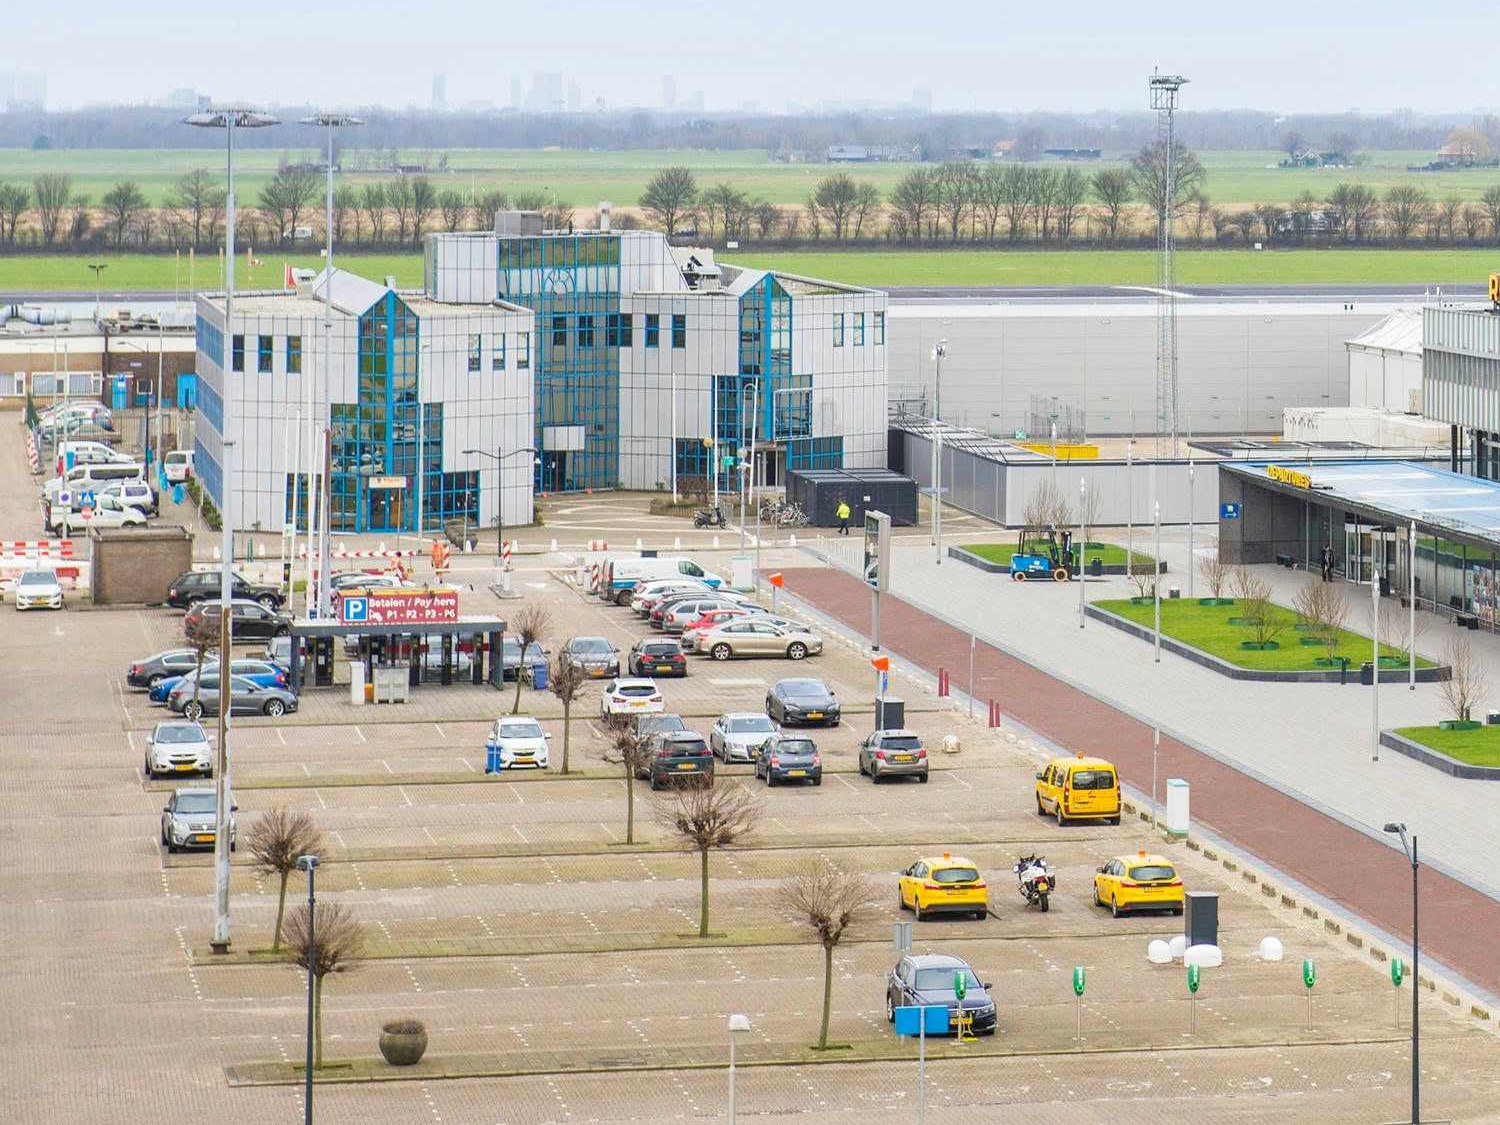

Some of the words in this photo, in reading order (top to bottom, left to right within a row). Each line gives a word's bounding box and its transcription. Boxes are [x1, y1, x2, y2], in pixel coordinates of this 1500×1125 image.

[1266, 464, 1311, 489] DEPARTURES
[349, 600, 363, 619] P
[369, 597, 405, 607] Betalen
[414, 598, 431, 609] Pay
[434, 597, 456, 607] here
[387, 610, 397, 619] P1
[406, 610, 417, 619] P2
[425, 609, 437, 619] P3
[444, 609, 456, 618] P6
